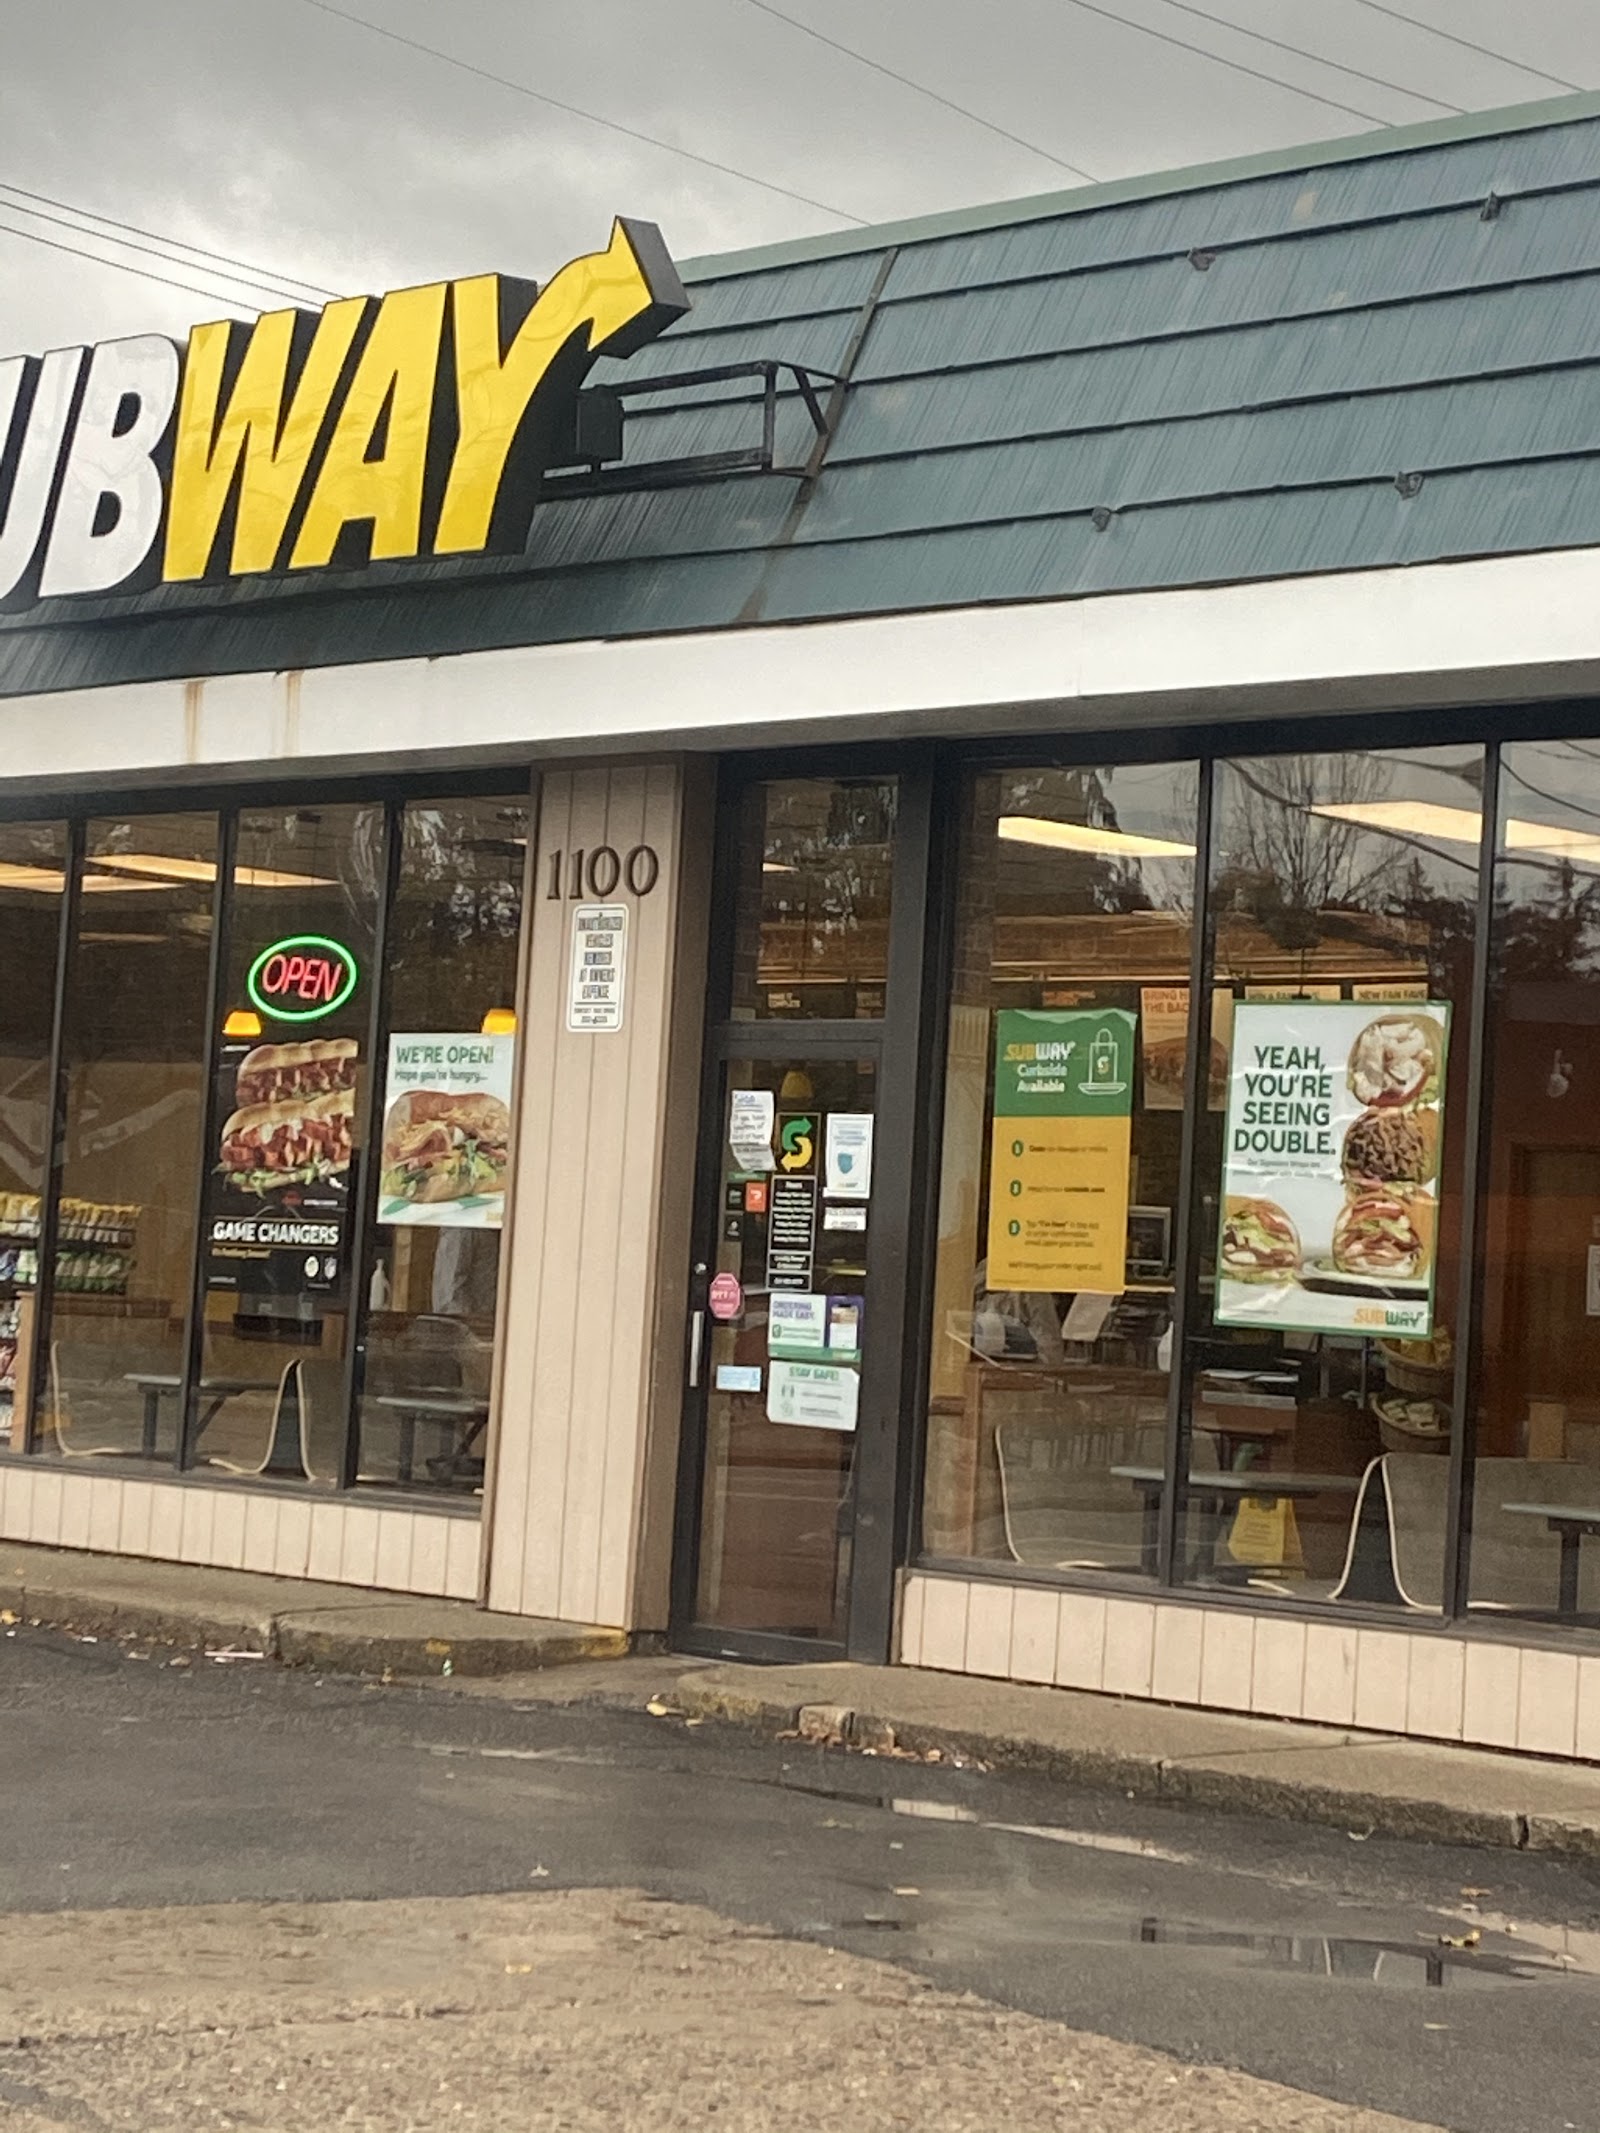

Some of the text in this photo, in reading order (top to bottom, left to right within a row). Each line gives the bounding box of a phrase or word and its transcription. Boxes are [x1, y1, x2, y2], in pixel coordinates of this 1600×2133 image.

[0, 216, 653, 602] UBWAY
[546, 844, 660, 900] 1100
[262, 953, 342, 1002] OPEN
[396, 1045, 494, 1064] WE'RE OPEN!
[1003, 1041, 1076, 1061] SUBWAY
[1254, 1045, 1326, 1074] YEAH,
[1017, 1063, 1067, 1077] Curbside
[1016, 1079, 1065, 1093] Available
[1244, 1073, 1333, 1098] YOU'RE
[1242, 1101, 1331, 1126] SEEING
[1233, 1128, 1336, 1156] DOUBLE.
[213, 1221, 339, 1245] GAME CHANGERS
[1354, 1307, 1424, 1327] SUBWAY
